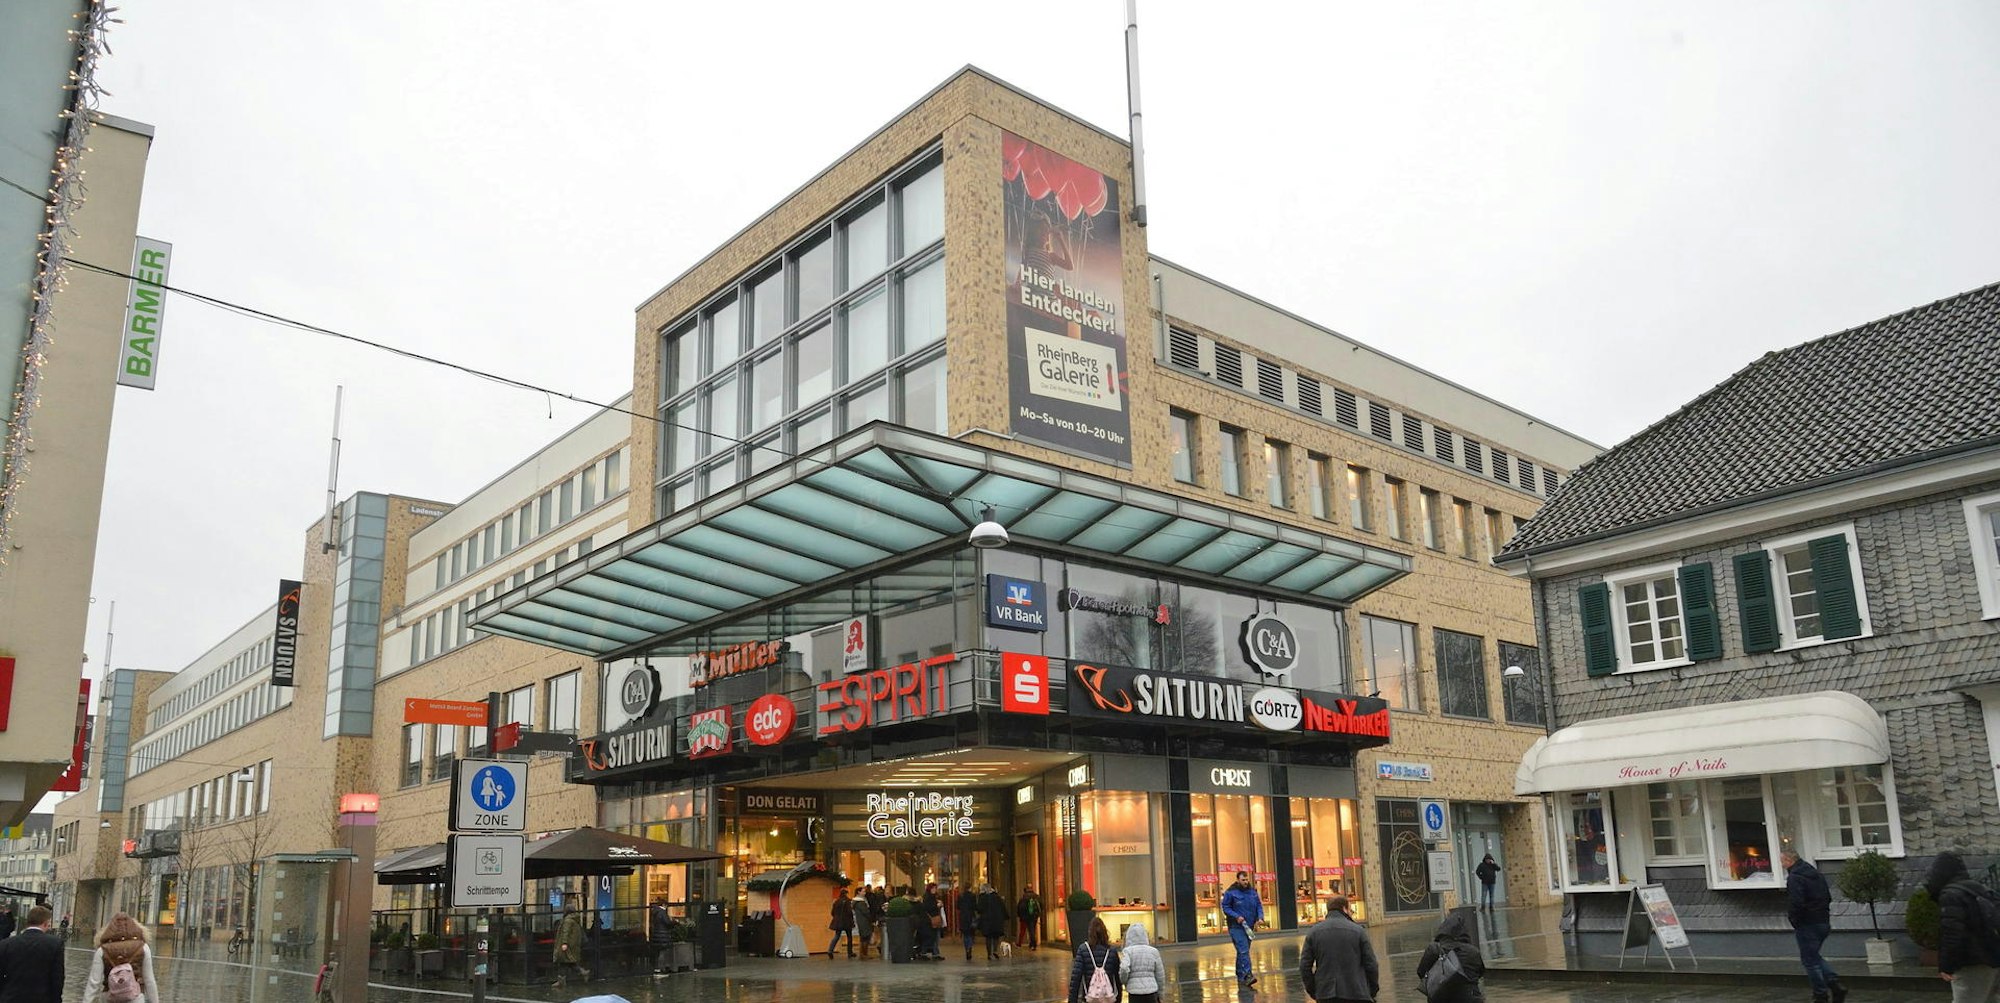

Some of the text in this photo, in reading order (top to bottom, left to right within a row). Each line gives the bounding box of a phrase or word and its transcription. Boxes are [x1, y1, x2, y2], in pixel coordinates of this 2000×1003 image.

[1021, 263, 1115, 314] Hier landen
[126, 248, 166, 377] BARMER
[1021, 285, 1116, 335] Entdecker!
[1037, 343, 1099, 374] RheinBerg
[1039, 359, 1100, 389] Galerie
[1056, 417, 1075, 431] von
[1107, 430, 1125, 445] Uhr
[996, 605, 1043, 625] VR Bank
[275, 616, 297, 679] SATURN
[1256, 628, 1293, 660] C&A
[709, 640, 782, 680] Müller
[624, 677, 648, 705] C&A
[819, 652, 956, 735] ESPRIT
[1134, 673, 1245, 723] SATURN
[753, 703, 783, 732] edc
[1254, 698, 1299, 720] GÖRTZ
[608, 725, 670, 769] SATURN
[1210, 767, 1252, 787] CHRIST
[1618, 757, 1728, 779] House of Nails
[747, 794, 817, 810] DON GELATI
[866, 791, 974, 816] RheinBerg
[474, 813, 509, 827] ZONE
[866, 810, 974, 839] Galerie
